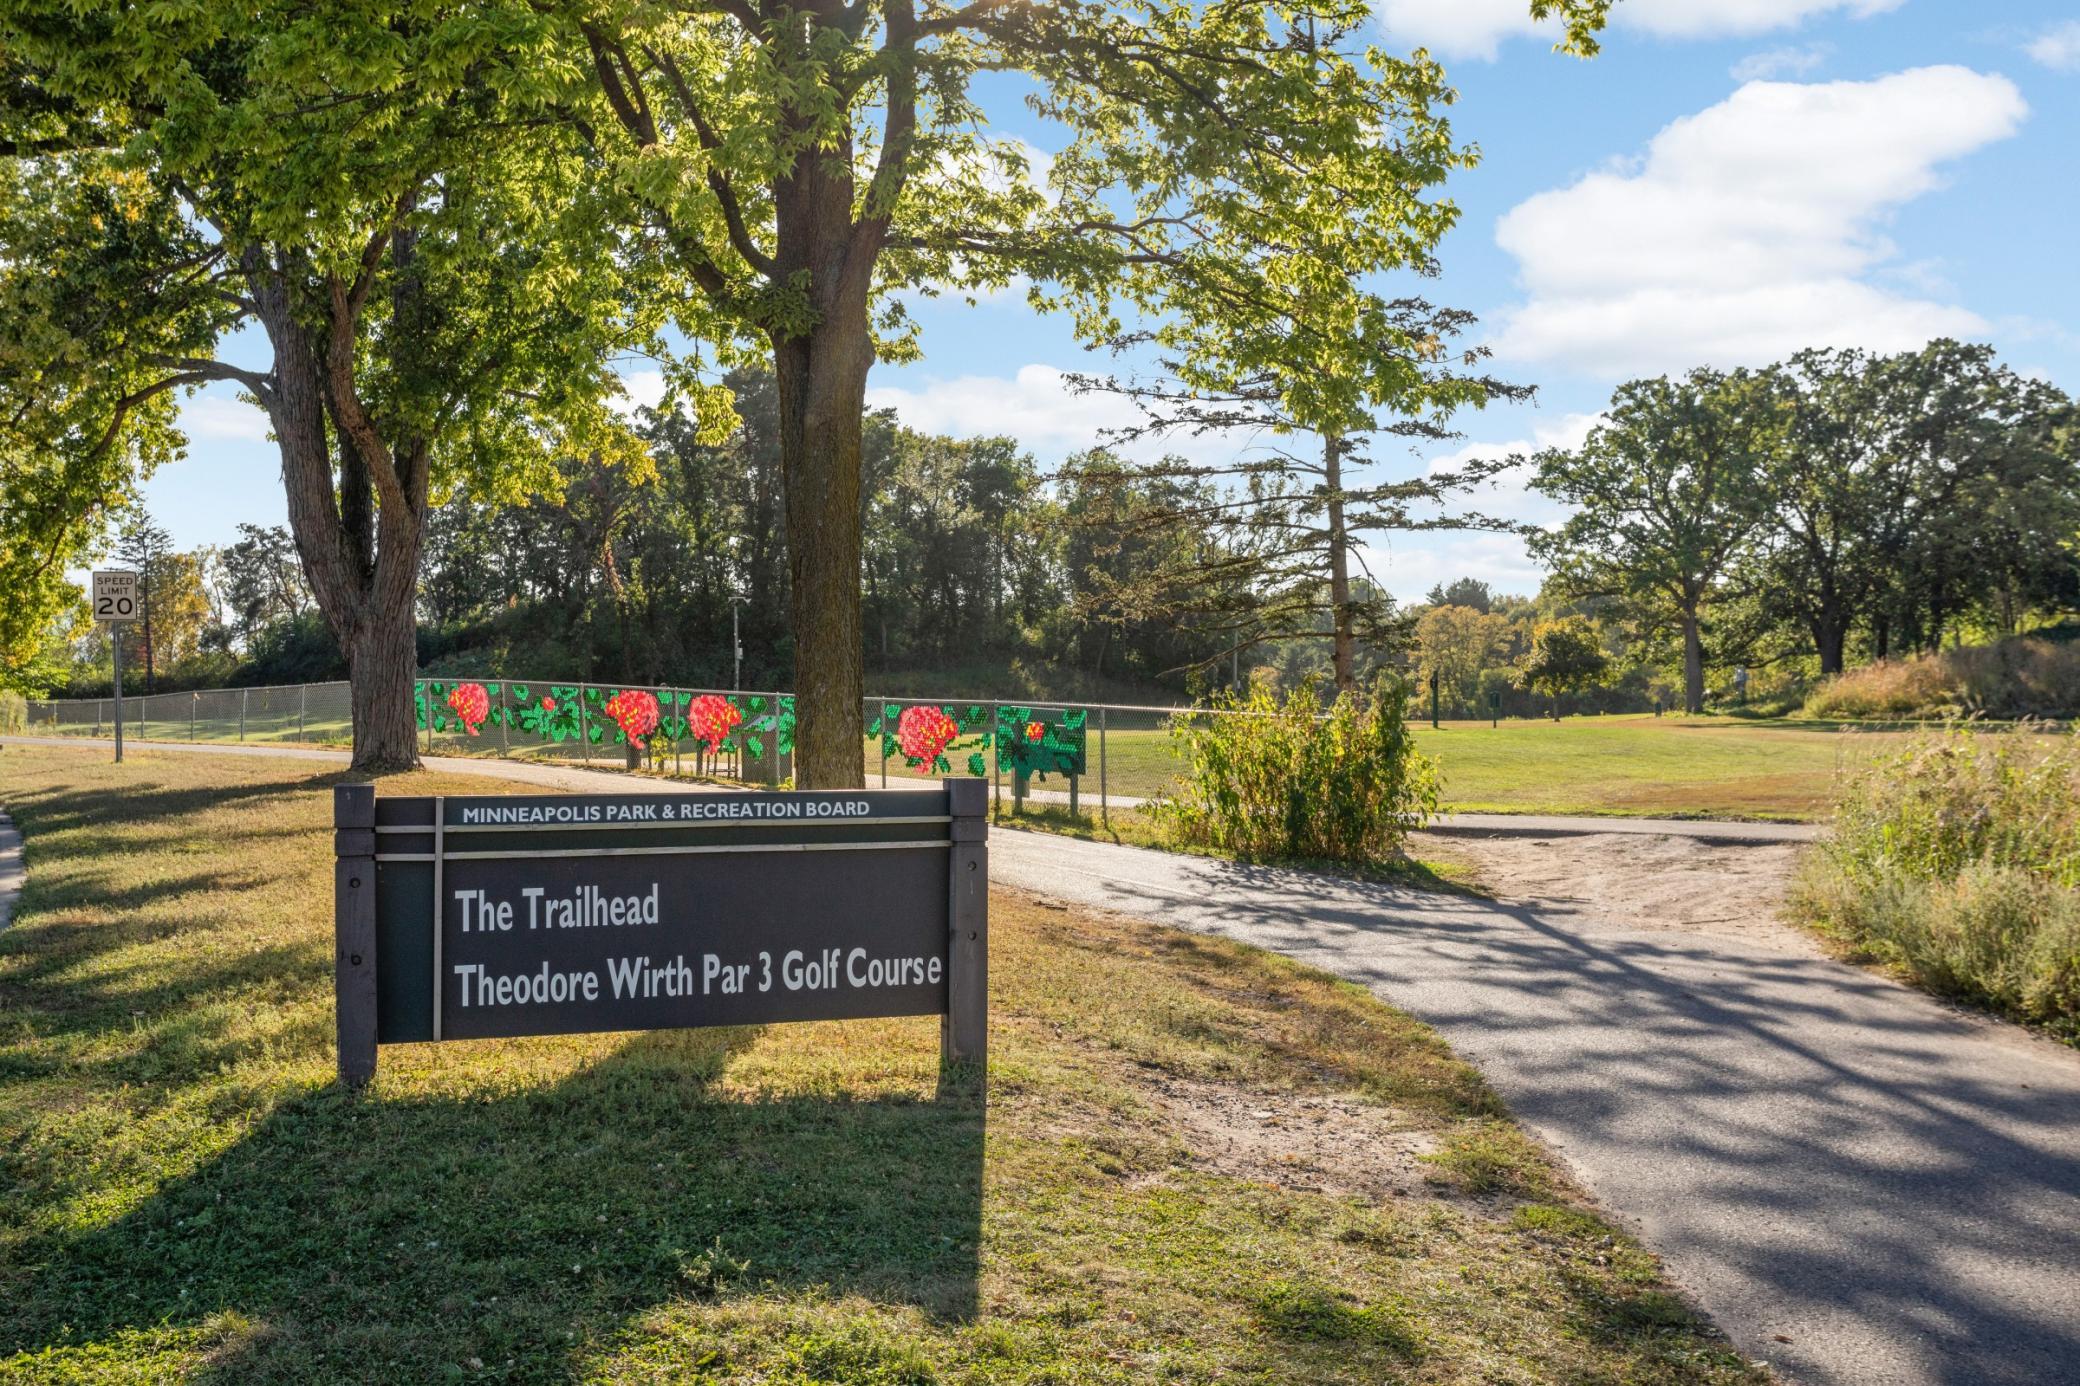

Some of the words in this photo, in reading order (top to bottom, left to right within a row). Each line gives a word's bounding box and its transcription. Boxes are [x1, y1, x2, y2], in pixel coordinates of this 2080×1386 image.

[97, 577, 133, 585] SPEED
[101, 587, 129, 595] LIMIT
[98, 597, 133, 615] 20
[463, 806, 601, 824] MINNEAPOLIS
[606, 804, 657, 822] PARK
[662, 804, 676, 819] &
[681, 803, 801, 819] RECREATION
[805, 801, 871, 817] BOARD
[455, 890, 513, 932] The
[523, 883, 659, 929] Trailhead
[455, 962, 599, 1007] Theodore
[607, 956, 693, 1000] Wirth
[704, 954, 751, 995] Par
[759, 952, 772, 992] 3
[783, 949, 841, 991] Golf
[847, 948, 942, 988] Course
